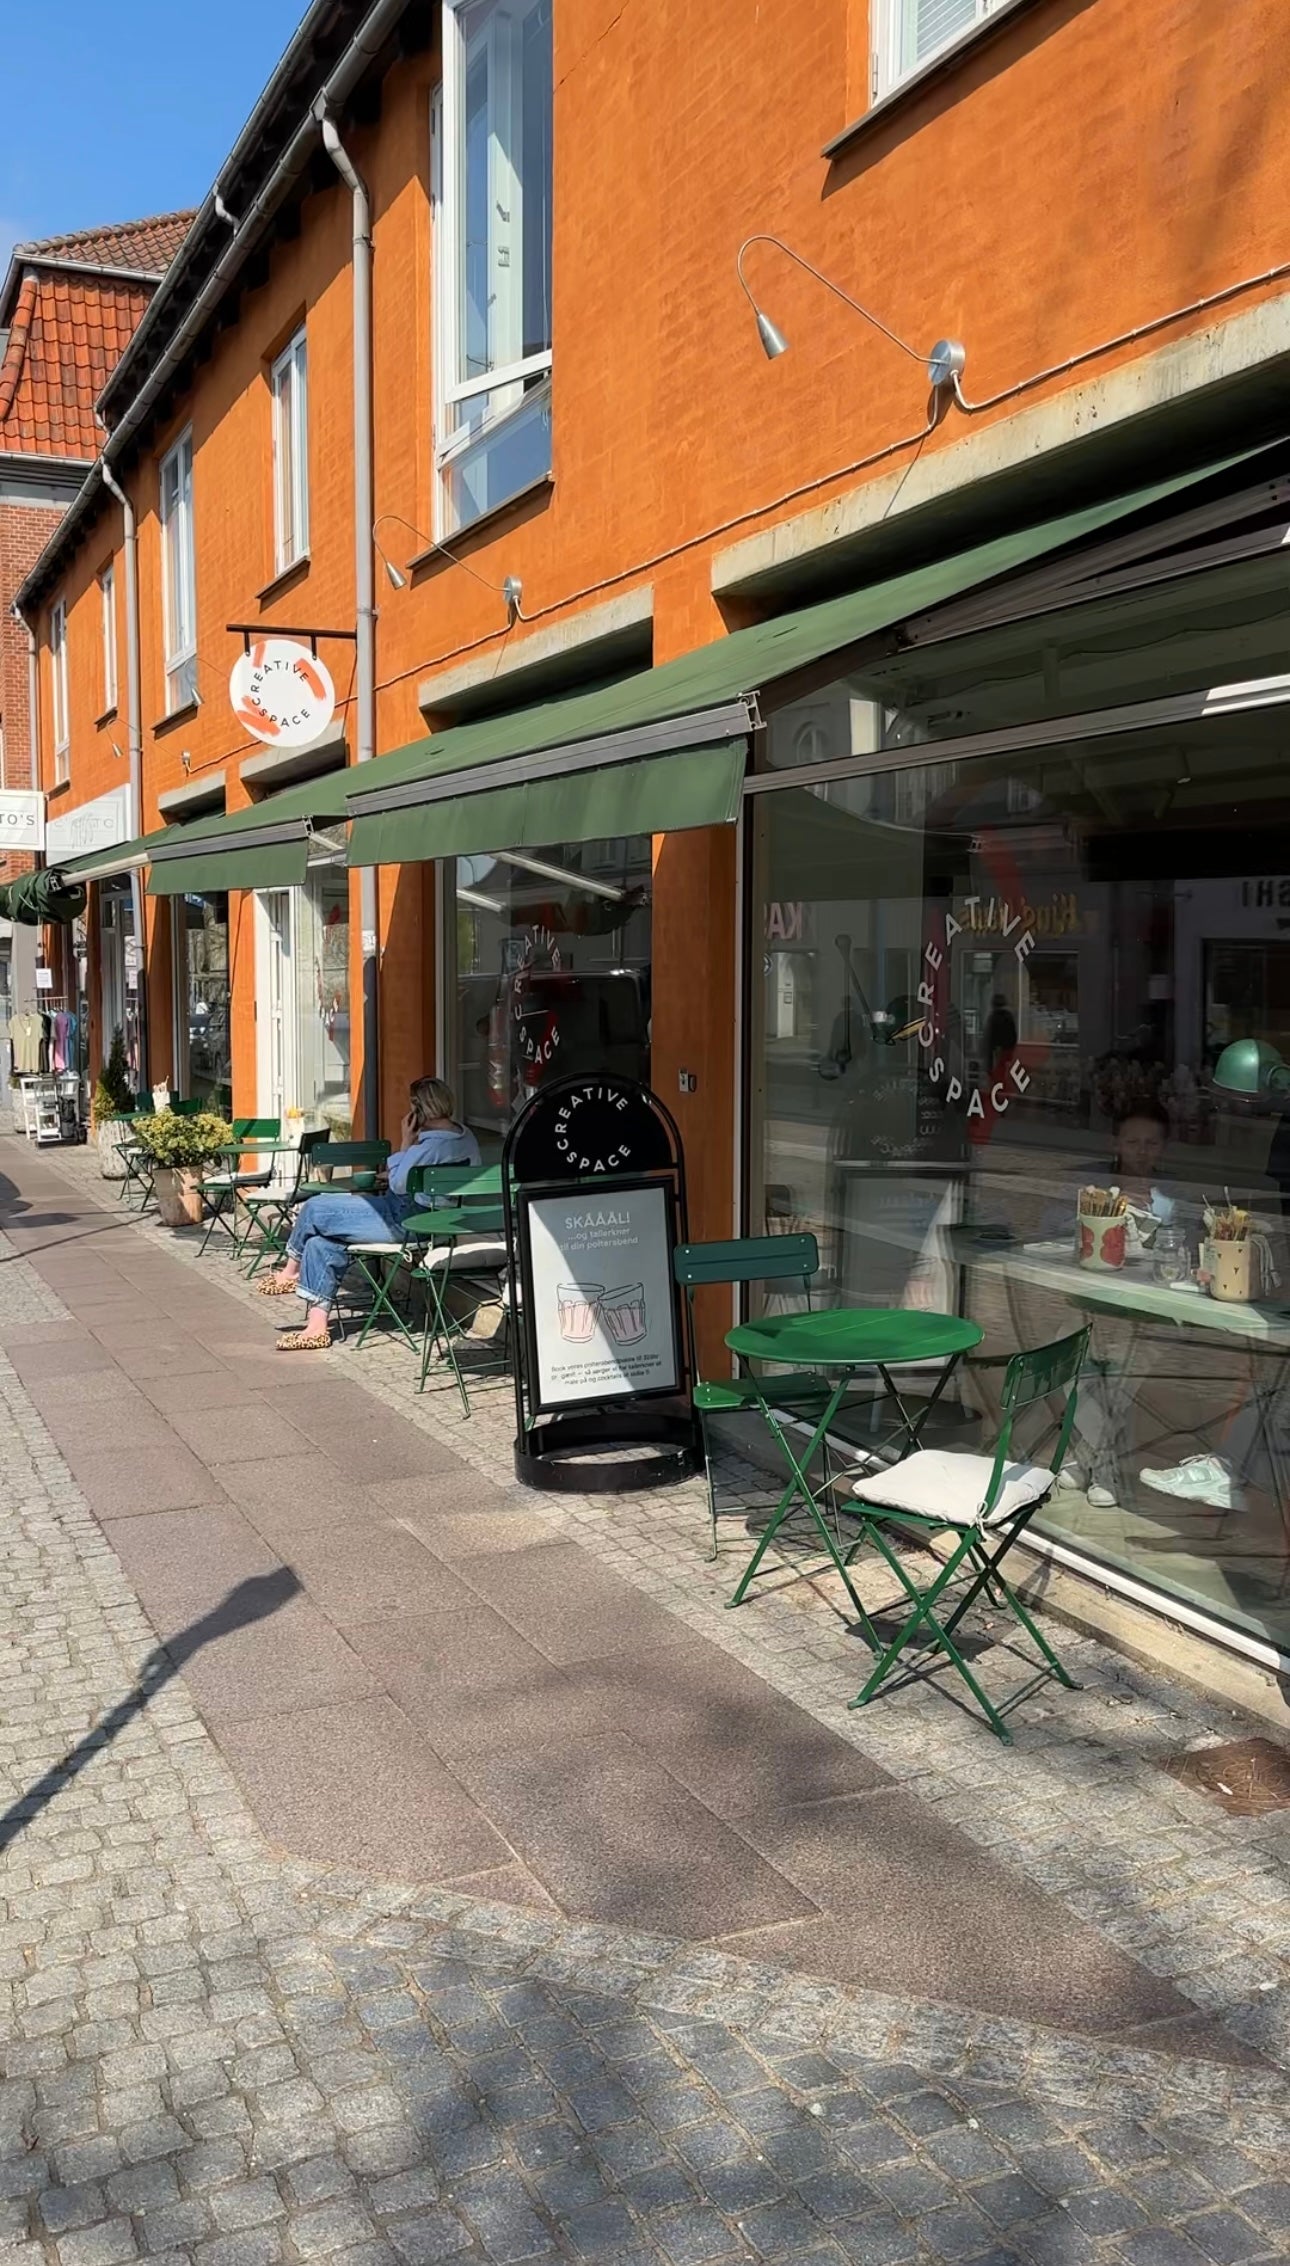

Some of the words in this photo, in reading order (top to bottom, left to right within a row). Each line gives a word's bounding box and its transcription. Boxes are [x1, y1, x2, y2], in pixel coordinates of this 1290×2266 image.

[250, 660, 309, 706] CREATIVE
[258, 708, 311, 728] SPACE
[514, 924, 560, 1020] CREATIVE
[917, 896, 1036, 1047] CREATIVE
[520, 1026, 560, 1064] SPACE
[928, 1056, 1031, 1119] SPACE
[554, 1087, 628, 1150] CREATIVE
[566, 1144, 631, 1172] SPACE
